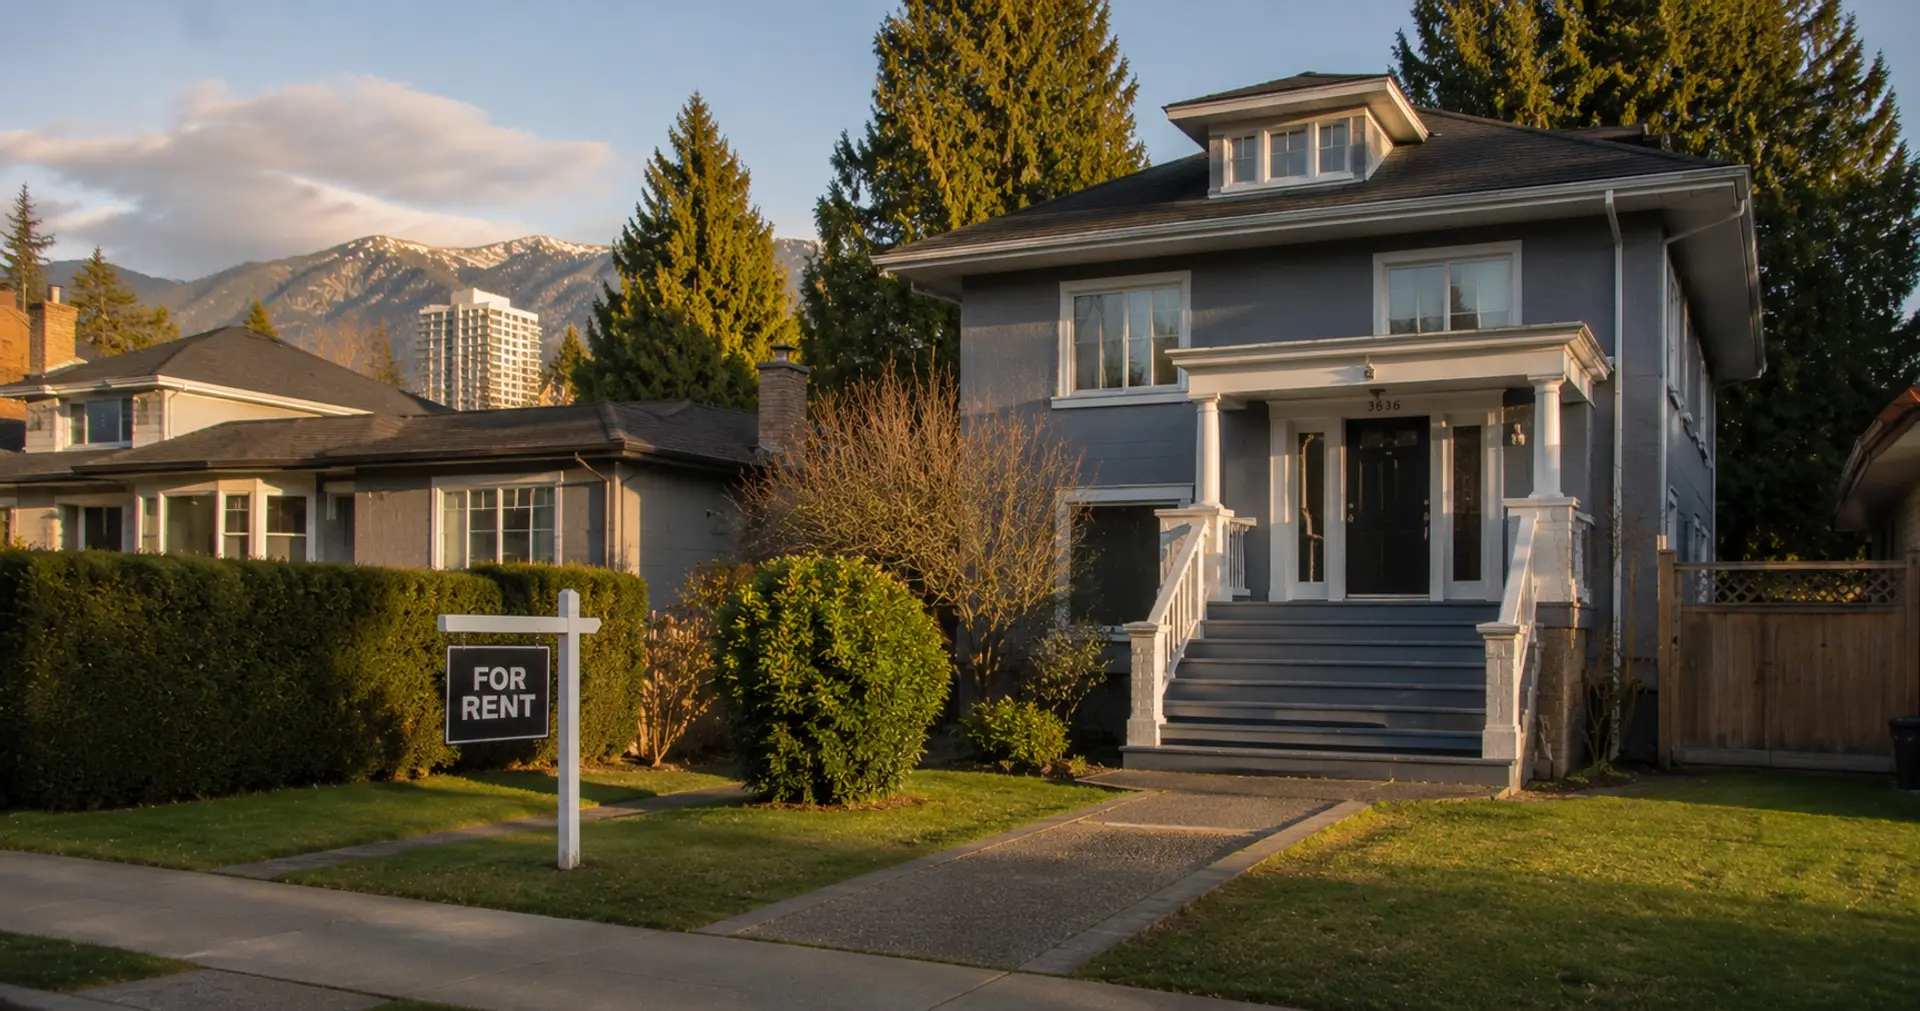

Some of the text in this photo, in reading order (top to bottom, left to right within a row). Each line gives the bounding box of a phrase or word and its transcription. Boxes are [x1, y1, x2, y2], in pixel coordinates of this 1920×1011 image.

[1367, 400, 1401, 412] 3636
[474, 666, 526, 690] FOR
[462, 694, 536, 720] RENT
